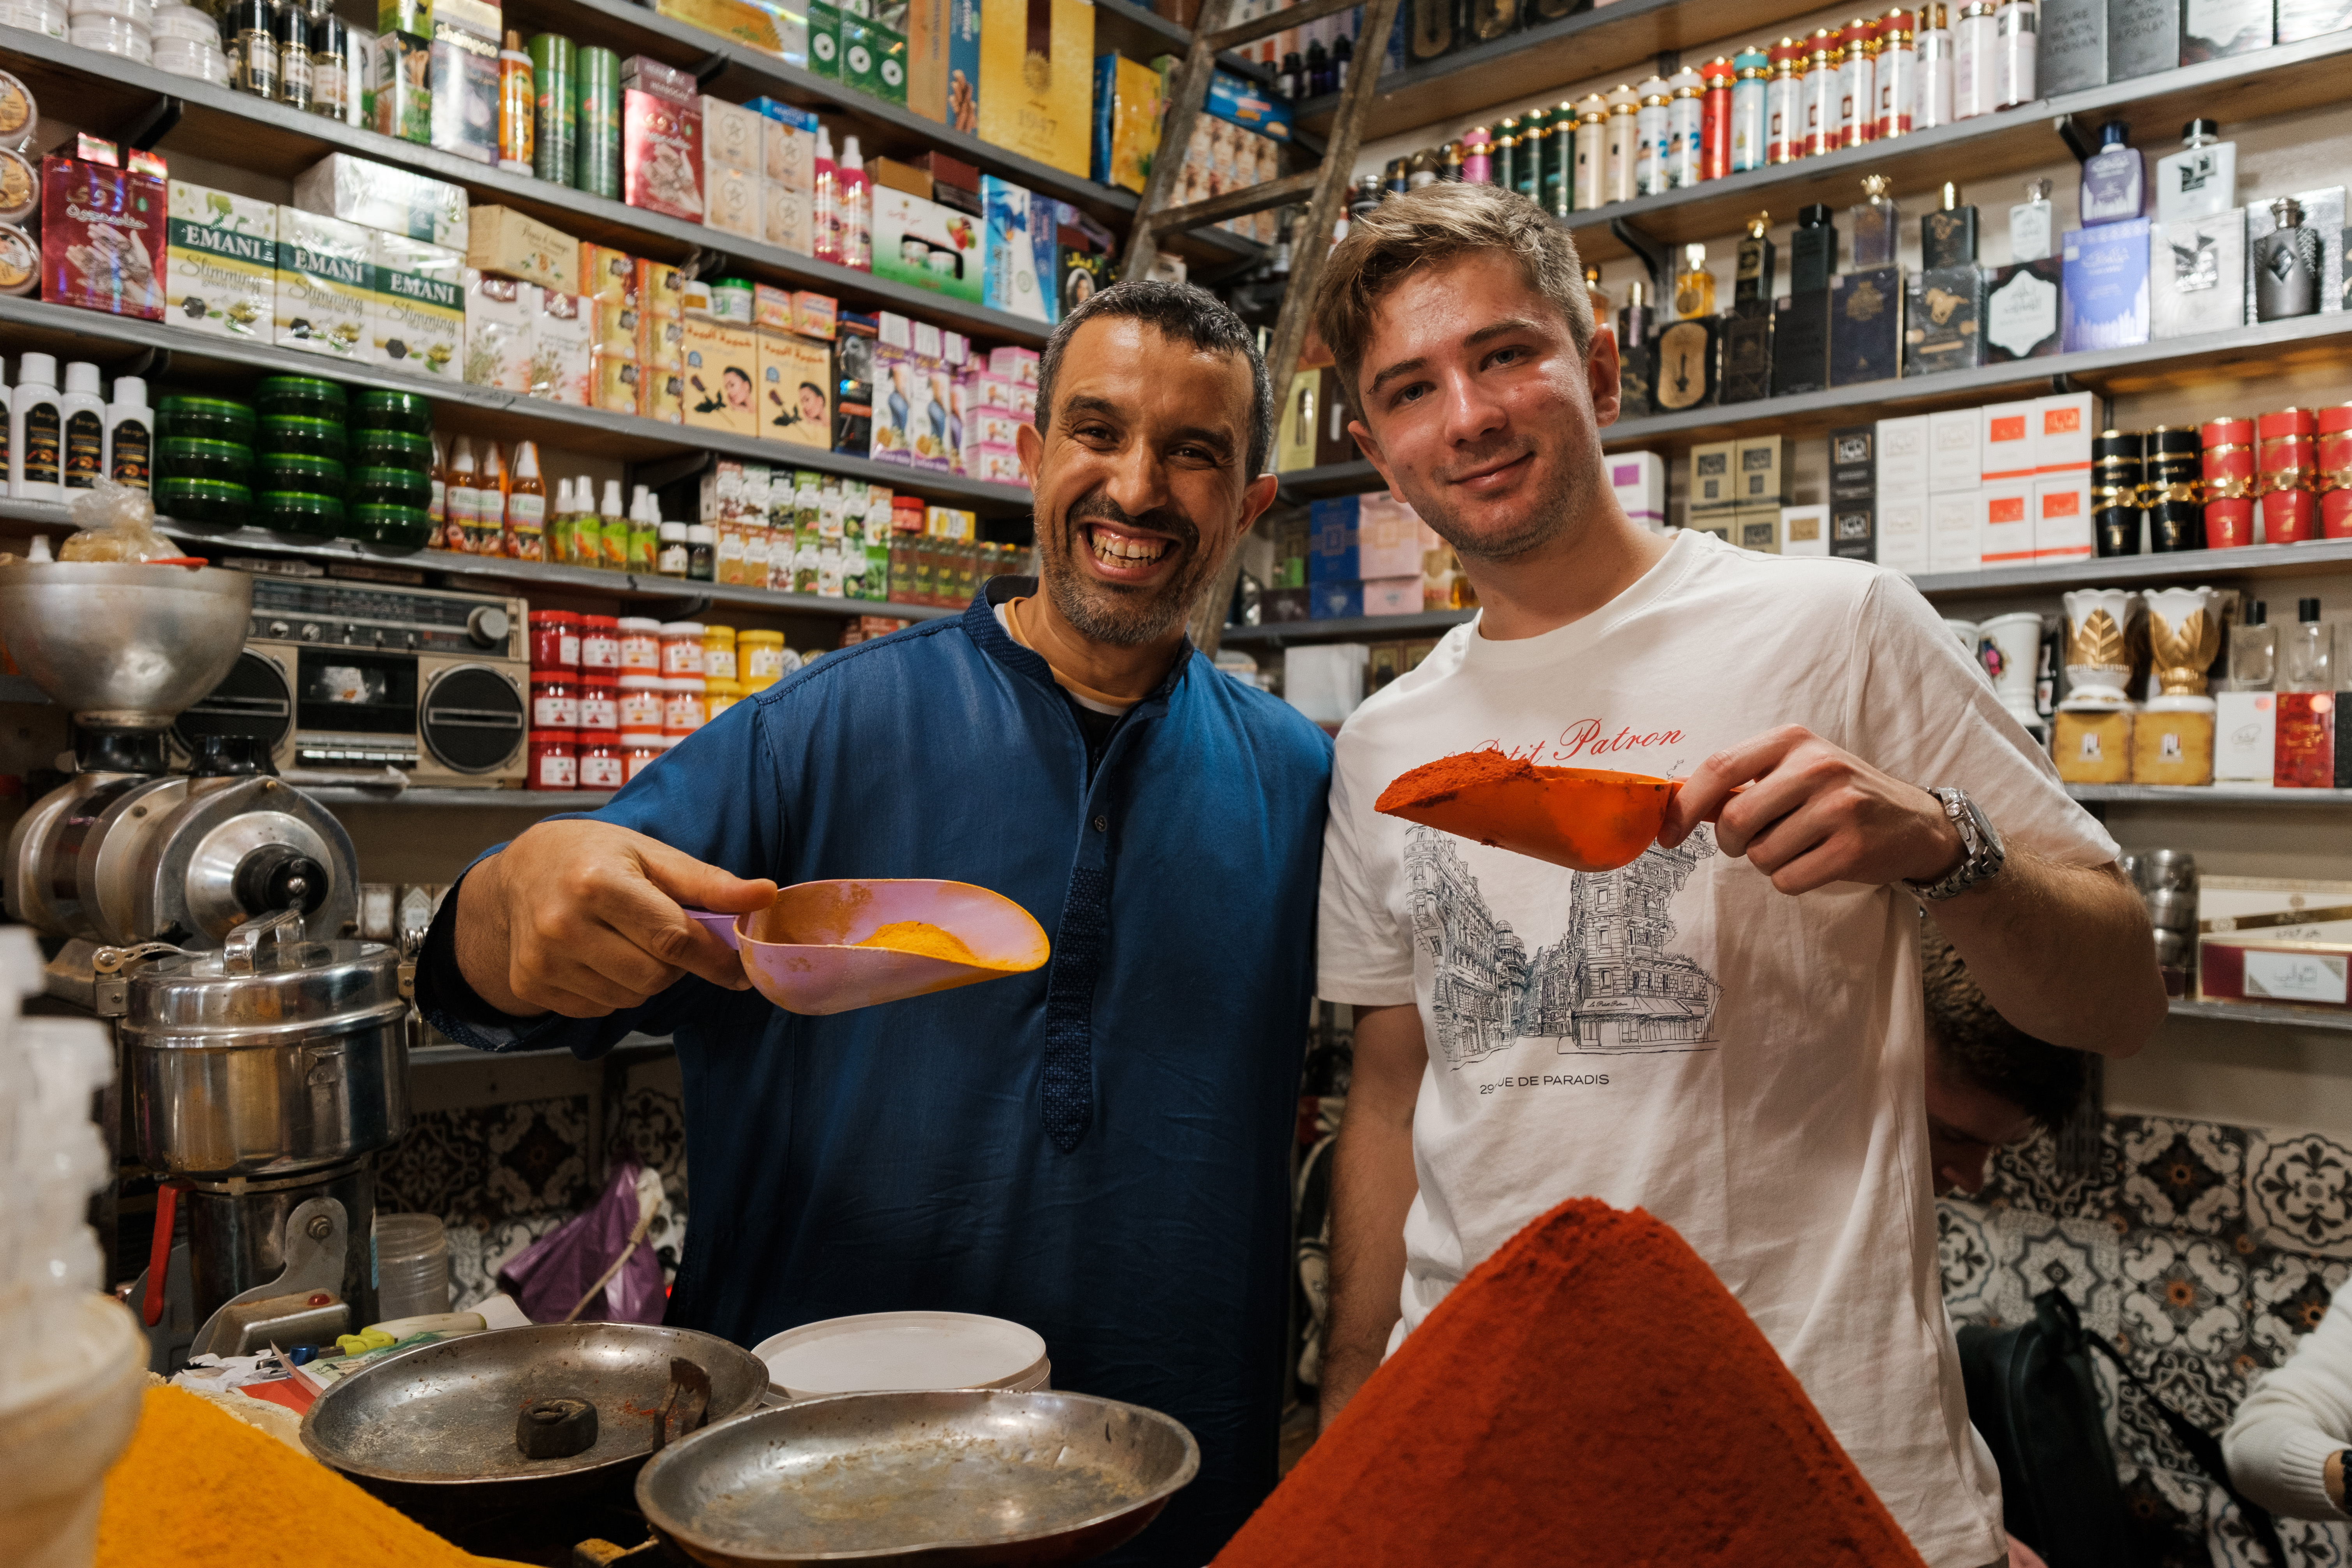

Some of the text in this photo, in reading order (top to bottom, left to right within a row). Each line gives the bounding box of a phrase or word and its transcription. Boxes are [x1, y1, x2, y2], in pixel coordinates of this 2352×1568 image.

[435, 21, 498, 58] shampoo
[185, 224, 261, 260] EMANI
[179, 254, 260, 295] Slimming
[294, 249, 362, 283] EMANI
[289, 277, 363, 317] Slimming
[390, 273, 455, 305] EMANI
[386, 300, 455, 338] Slimming
[1553, 718, 1686, 761] Patron
[1480, 1074, 1610, 1094] 29 UE DE PARADIS
